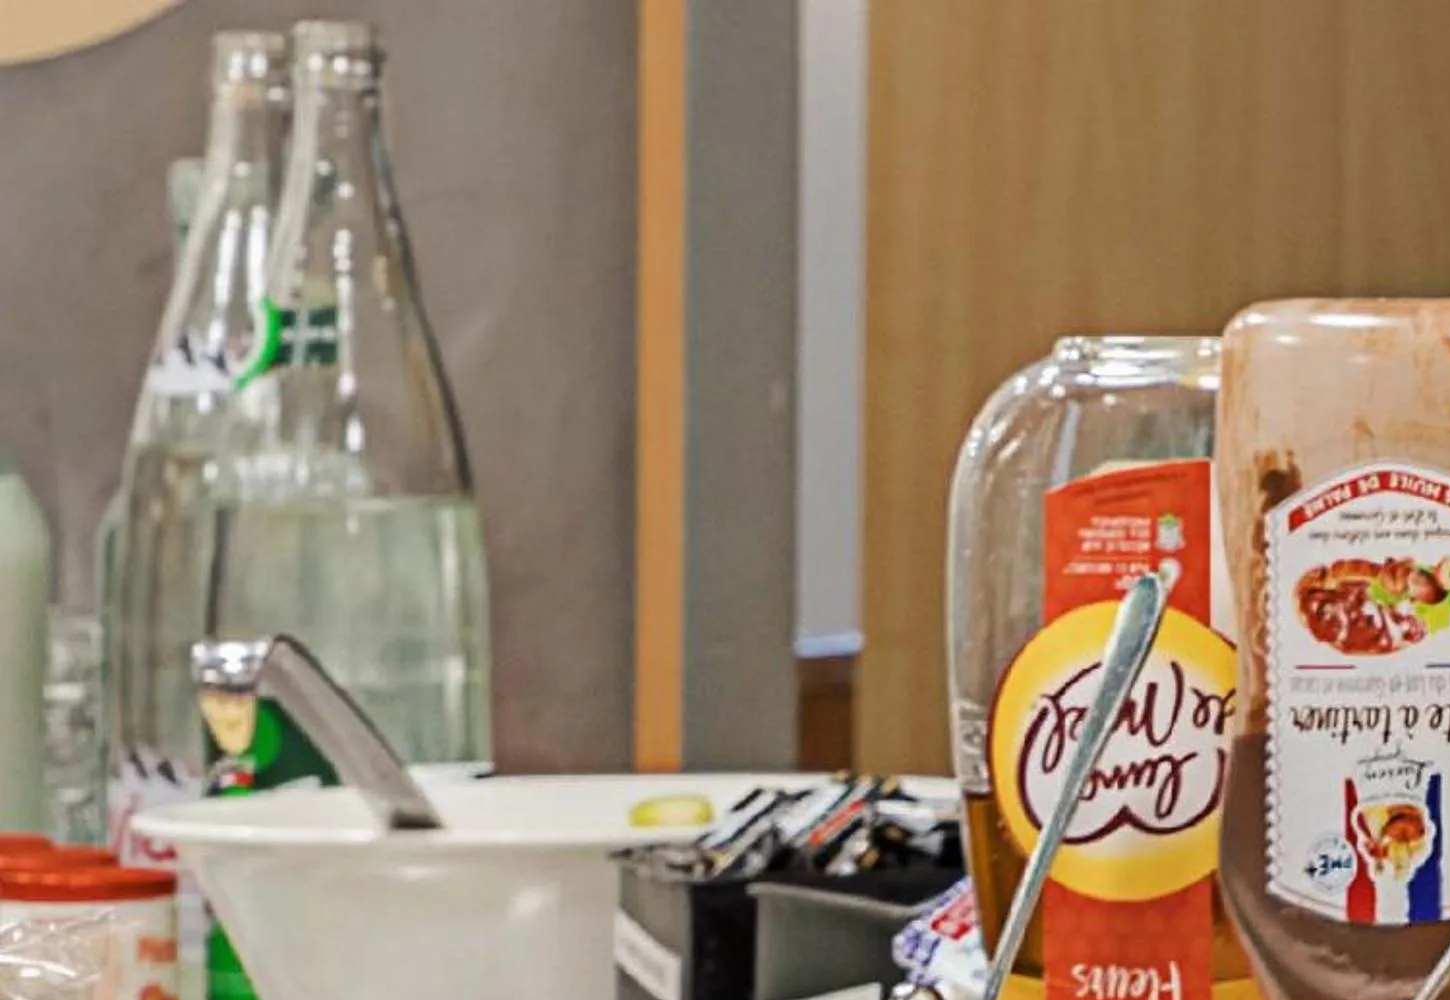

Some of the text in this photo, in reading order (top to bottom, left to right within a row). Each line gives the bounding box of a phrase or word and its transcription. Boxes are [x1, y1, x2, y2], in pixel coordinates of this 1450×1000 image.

[1302, 479, 1351, 518] PALME
[1358, 474, 1380, 492] DE
[1390, 472, 1441, 498] HUILE
[1040, 662, 1184, 775] Mel
[1289, 704, 1393, 745] tartiner
[1397, 704, 1421, 741] à
